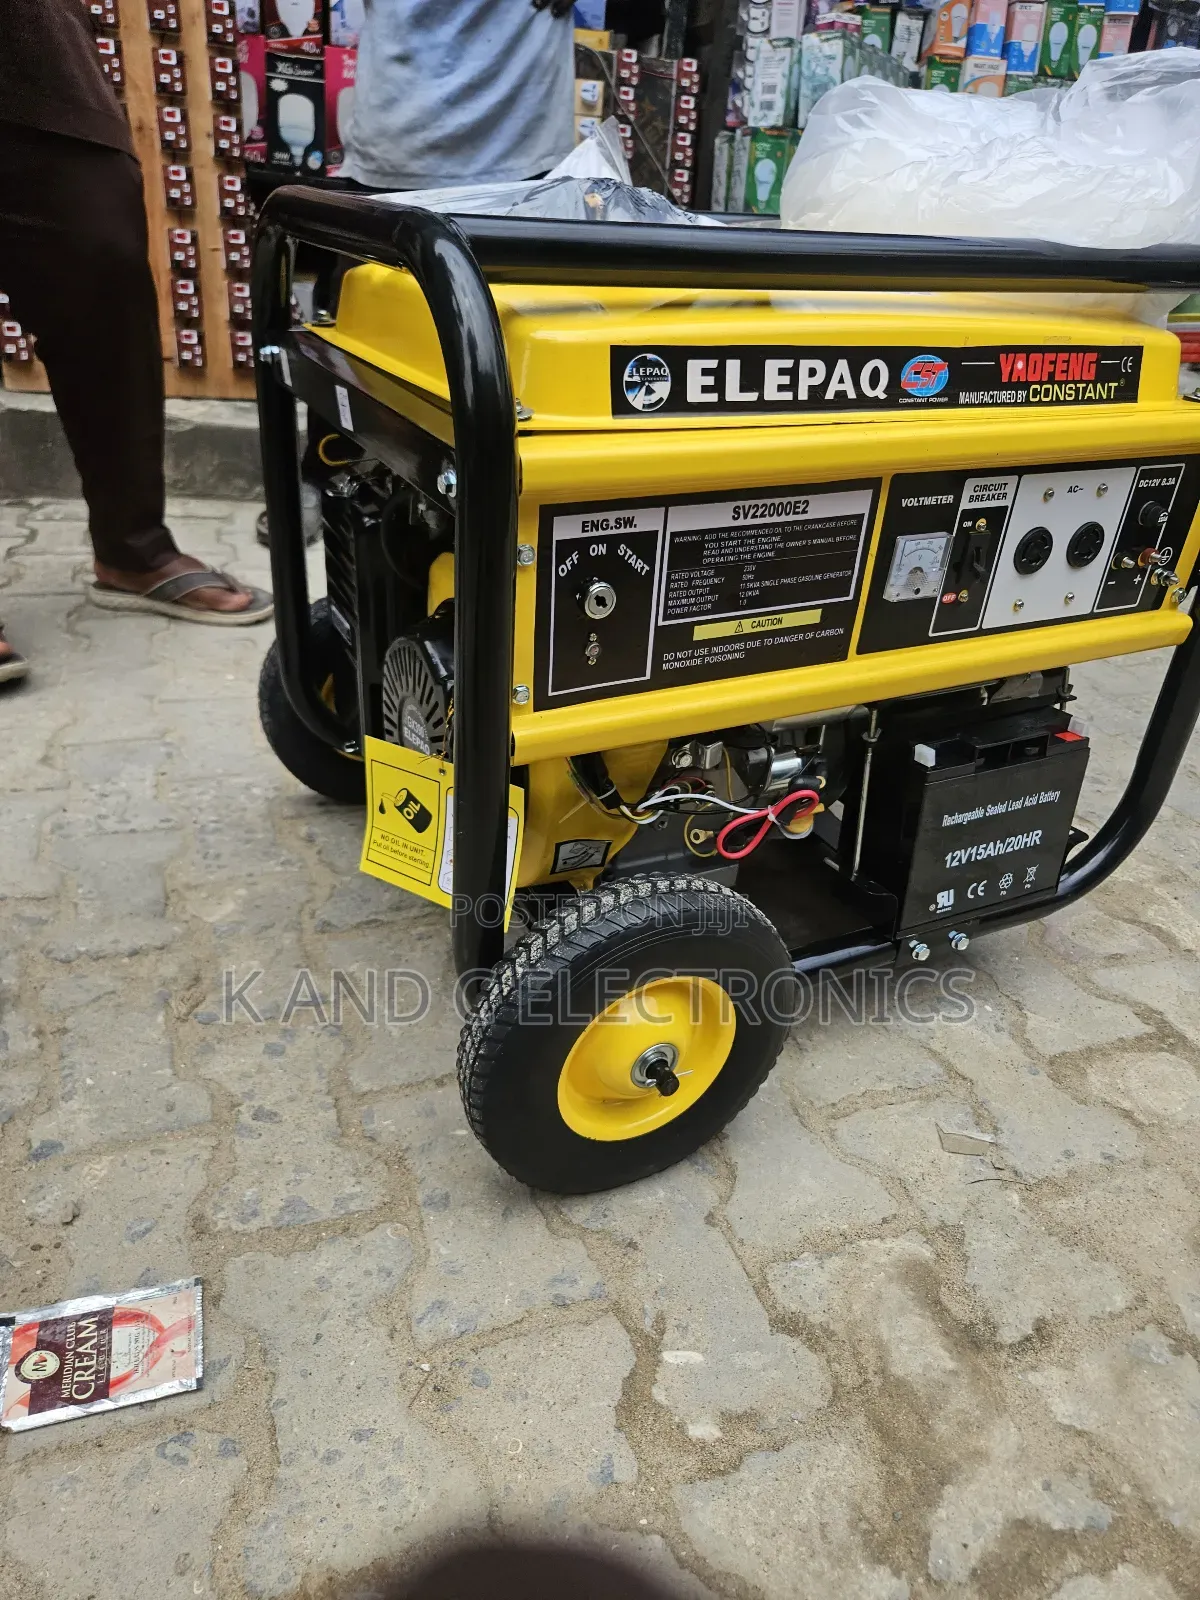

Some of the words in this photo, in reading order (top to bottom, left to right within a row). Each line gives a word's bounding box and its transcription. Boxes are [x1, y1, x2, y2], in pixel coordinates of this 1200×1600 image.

[628, 367, 668, 376] ELEPAQ
[1000, 352, 1098, 382] YAOFENG
[686, 358, 890, 403] ELEPAQ
[901, 361, 949, 389] CST
[958, 390, 1016, 405] MANUFACTURED
[1017, 390, 1027, 402] BY
[1029, 382, 1119, 402] CONSTANT
[973, 482, 1009, 494] CIRCUIT
[1138, 478, 1162, 488] DC12V
[901, 494, 954, 508] VOLTMETER
[968, 492, 1008, 504] BREAKER
[731, 499, 810, 521] SV22000E2
[581, 515, 638, 534] ENG.SW.
[793, 524, 802, 532] THE
[962, 520, 973, 528] ON
[589, 543, 607, 557] ON
[720, 539, 742, 548] START
[774, 542, 785, 550] THE
[558, 551, 580, 577] OFF
[617, 543, 650, 576] START
[702, 555, 739, 565] OPERATING
[670, 572, 690, 580] RATED
[690, 569, 716, 578] VOLTAGE
[669, 581, 689, 589] RATED
[691, 576, 726, 587] FREQUENCY
[687, 587, 711, 596] OUTPUT
[667, 598, 696, 607] MAXIMUM
[696, 594, 719, 604] OUTPUT
[667, 606, 689, 616] POWER
[689, 603, 712, 613] FACTOR
[750, 616, 783, 629] CAUTION
[663, 652, 675, 661] DO
[676, 649, 693, 659] NOT
[694, 647, 710, 657] USE
[710, 642, 745, 654] INDOORS
[746, 639, 762, 649] DUE
[763, 637, 773, 646] TO
[773, 633, 804, 645] DANGER
[804, 630, 815, 640] OF
[815, 627, 845, 638] CARBON
[662, 657, 703, 671] MONOXIDE
[704, 651, 746, 664] POISONING
[403, 800, 421, 821] OIL
[942, 807, 984, 827] Rechargeable
[986, 801, 1007, 816] Sealed
[1008, 797, 1023, 811] Lead
[1024, 794, 1039, 807] Acid
[1039, 790, 1060, 802] Battery
[380, 833, 390, 843] NO
[390, 837, 402, 848] OIL
[401, 842, 409, 851] IN
[944, 829, 1043, 869] 12V15Ah/20HR
[390, 846, 408, 859] before
[71, 1314, 100, 1400] CREAM
[60, 1351, 76, 1398] MERIDIAN
